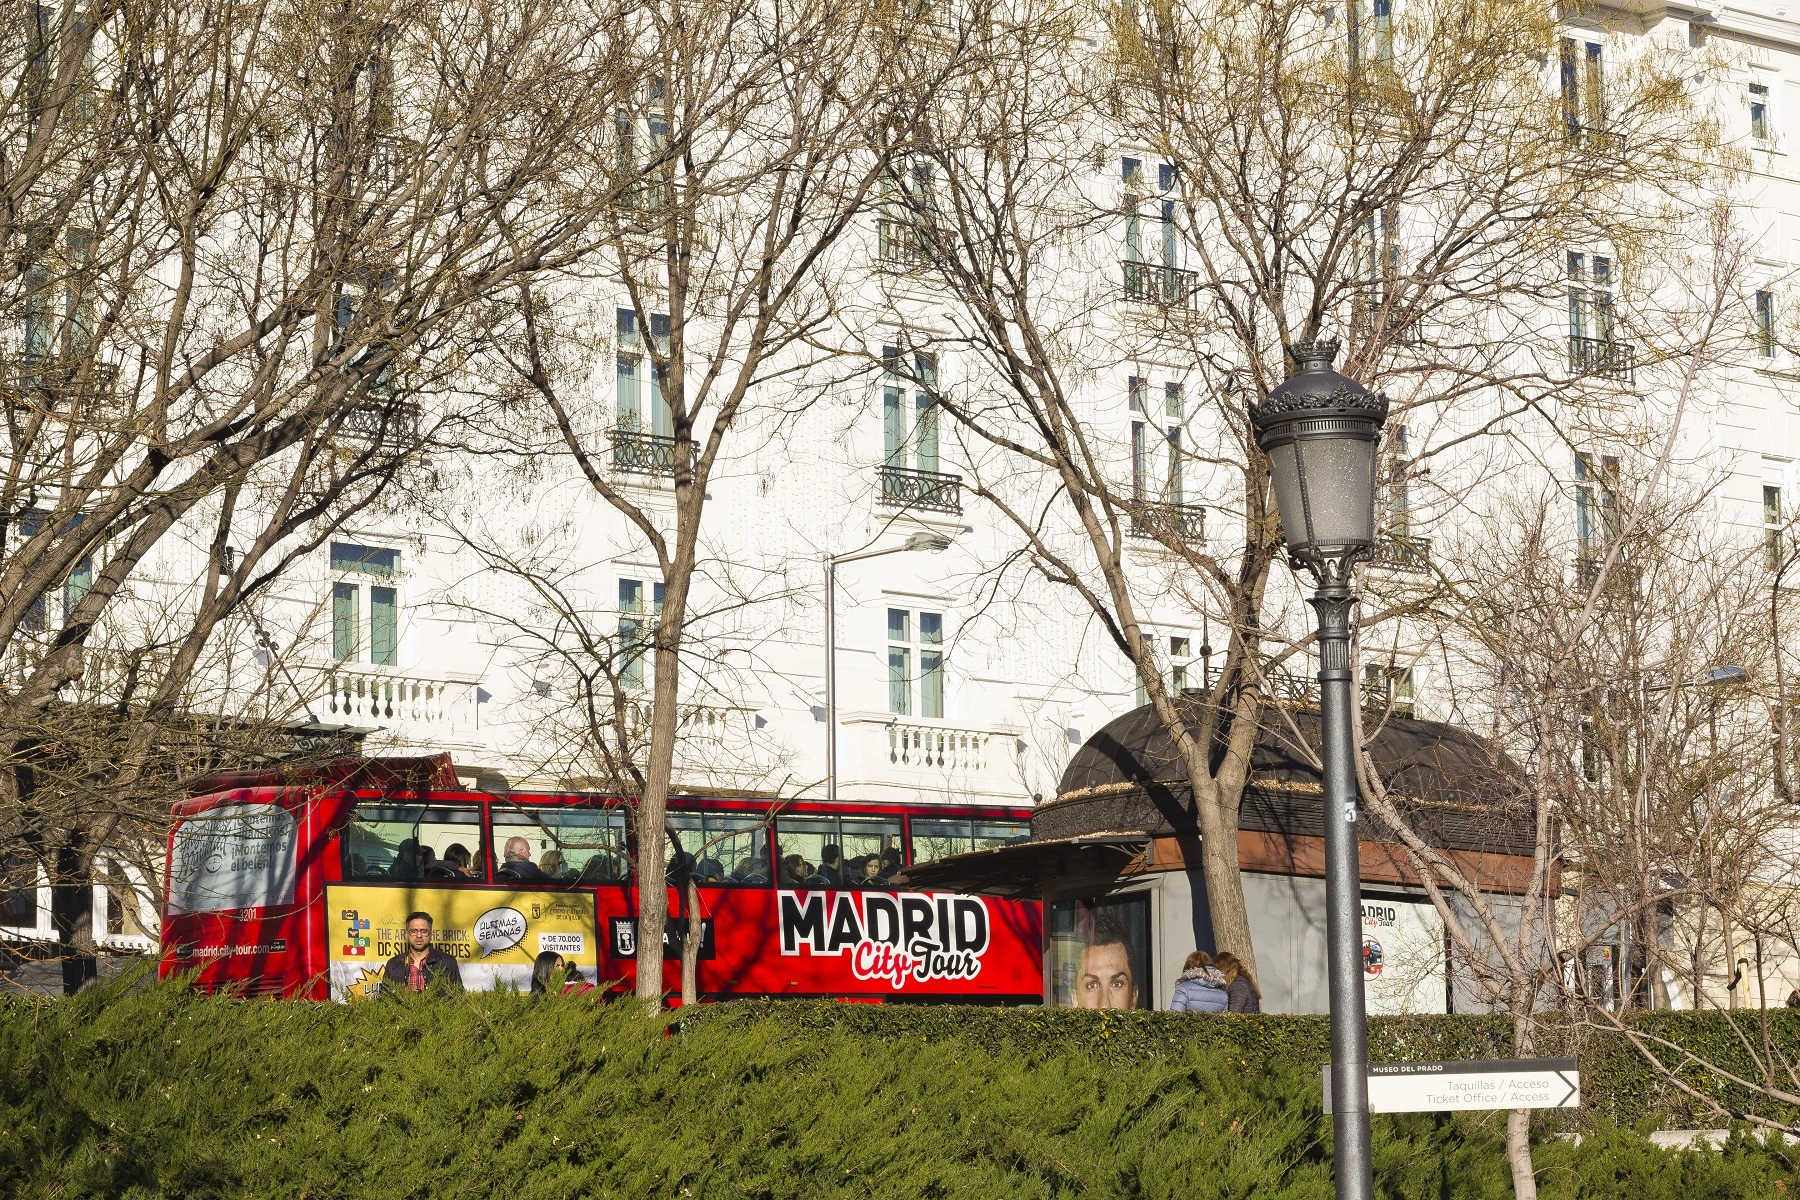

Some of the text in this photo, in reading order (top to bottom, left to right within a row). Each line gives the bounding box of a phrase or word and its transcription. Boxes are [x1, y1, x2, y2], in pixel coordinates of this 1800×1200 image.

[231, 841, 287, 859] ¡Montemos
[230, 855, 272, 871] el belén!
[239, 908, 257, 922] 3201
[1360, 905, 1396, 921] ADRID
[480, 917, 518, 931] ÚLTIMAS
[778, 891, 989, 956] MADRID
[376, 928, 393, 940] THE
[395, 928, 408, 940] AR
[442, 929, 470, 942] BRICK:
[479, 926, 522, 941] SEMANAS
[192, 944, 270, 958] madrid.city-tour.com
[377, 942, 392, 957] DC
[542, 944, 581, 952] VISITANTES
[856, 940, 979, 987] City Tour
[1447, 1079, 1550, 1092] Taquillas / Acceso
[1426, 1092, 1550, 1104] Ticket Office / Access
